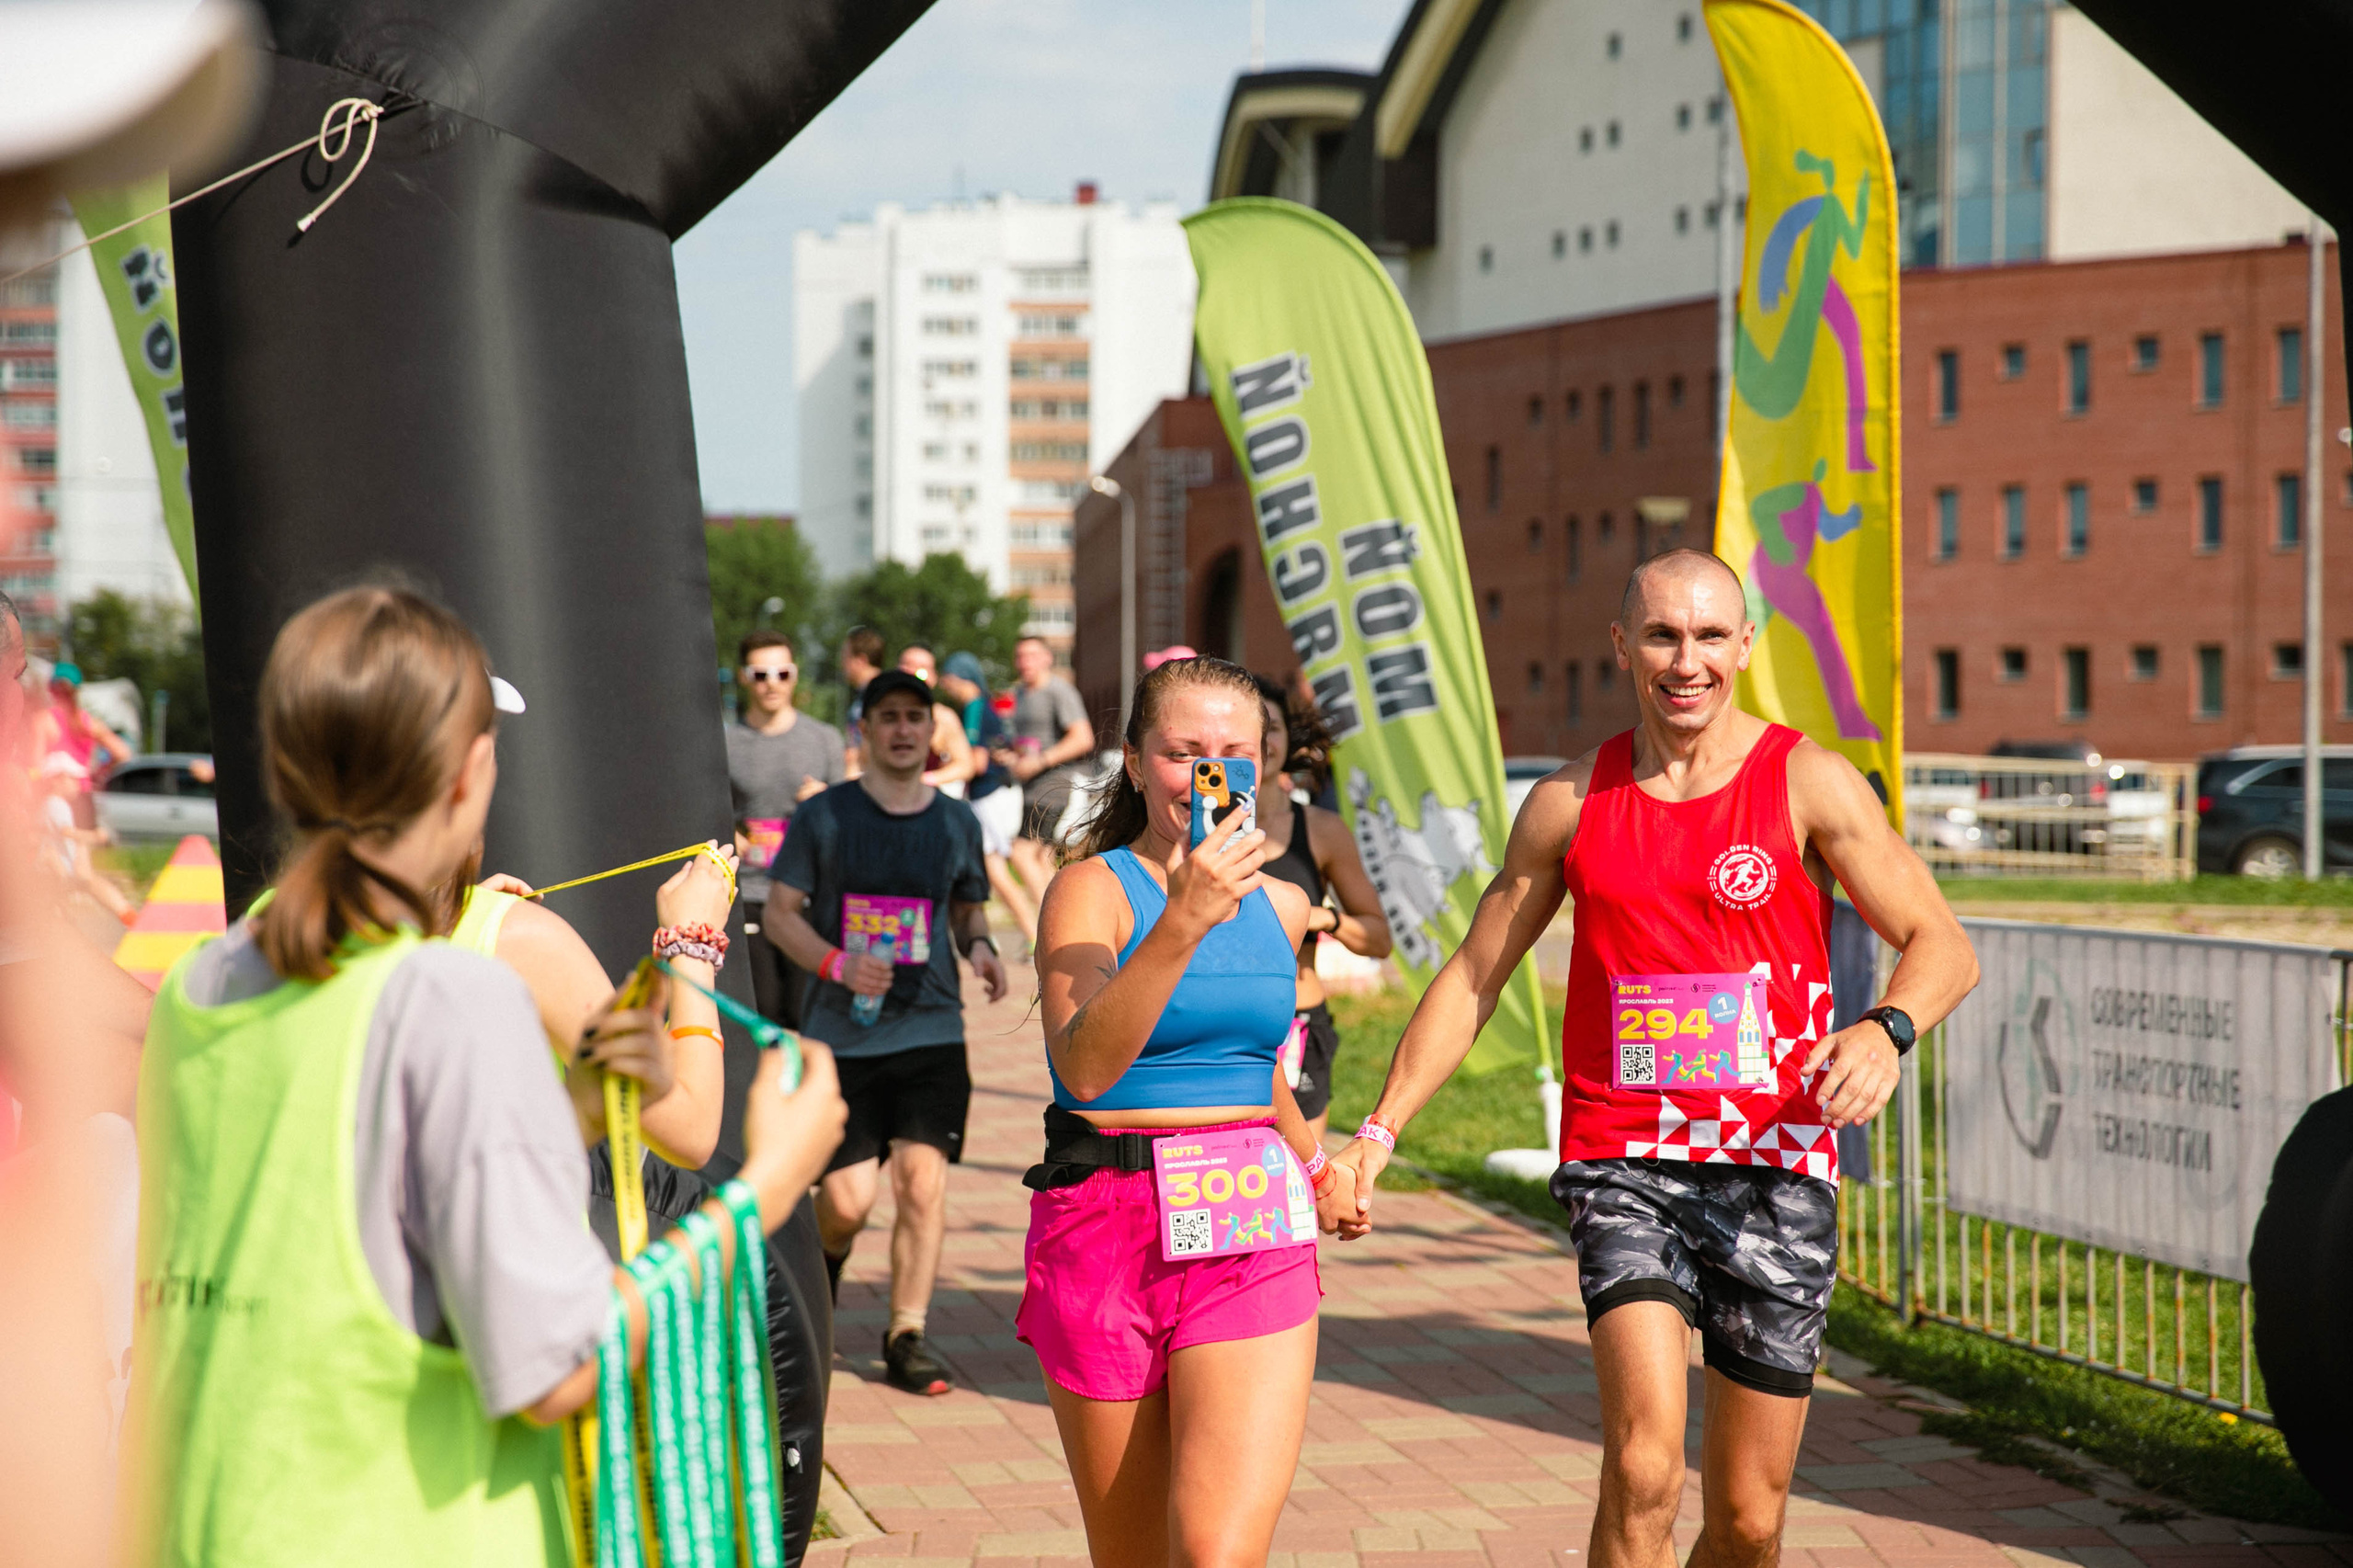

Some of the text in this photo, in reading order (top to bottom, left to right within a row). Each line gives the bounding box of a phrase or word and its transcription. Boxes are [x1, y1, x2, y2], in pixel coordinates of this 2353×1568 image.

[1713, 845, 1773, 865] GOLDEN RING
[1714, 892, 1772, 911] ULTRA TRAIL
[845, 913, 901, 936] 332
[1618, 984, 1652, 994] RUTS
[1717, 996, 1728, 1010] 1
[2090, 986, 2235, 1040] СОВРЕМЕННЫЕ
[1619, 1008, 1713, 1040] 294
[2092, 1049, 2242, 1110] ТРАНСПОРТНЫЕ
[1162, 1145, 1204, 1159] RUTS
[2092, 1111, 2211, 1172] ТЕХНОЛОГИИ
[1268, 1148, 1279, 1163] 1
[1166, 1165, 1268, 1207] 300
